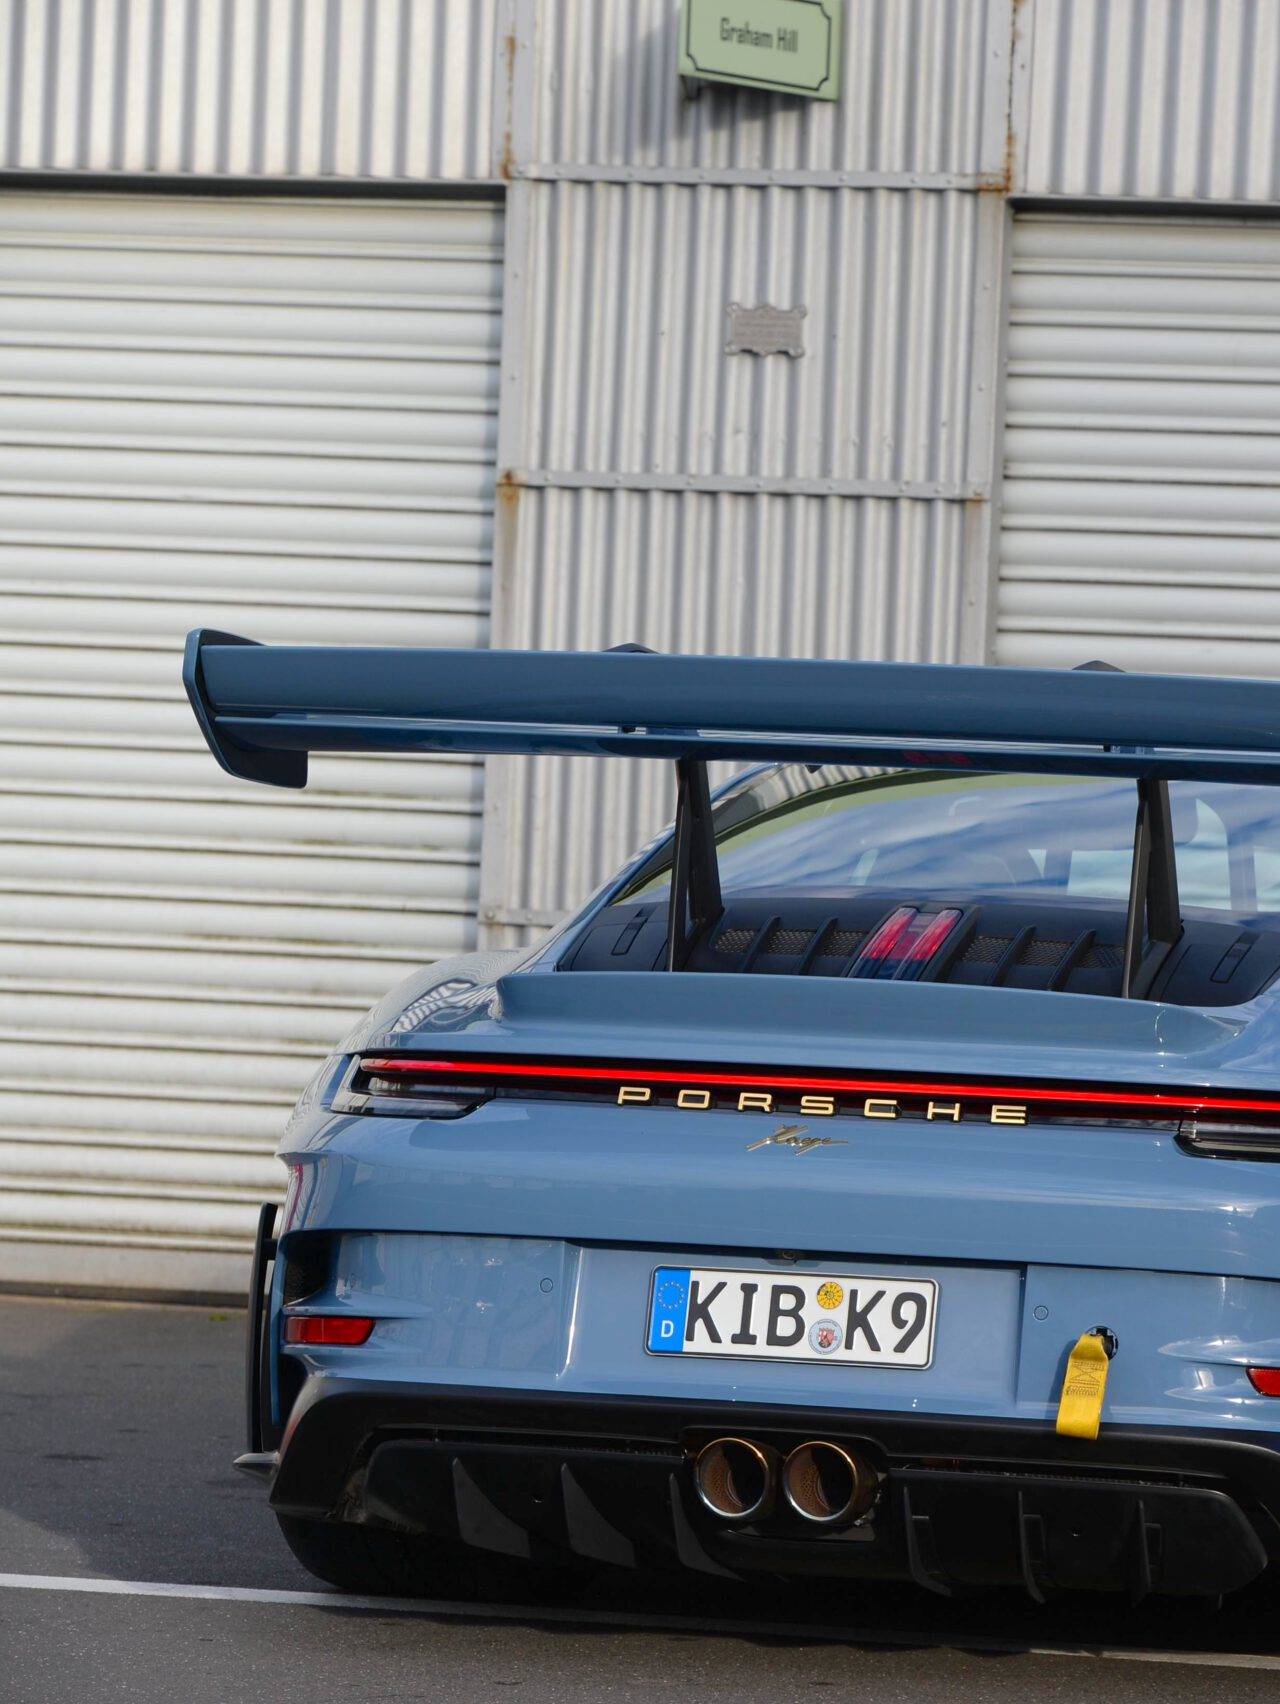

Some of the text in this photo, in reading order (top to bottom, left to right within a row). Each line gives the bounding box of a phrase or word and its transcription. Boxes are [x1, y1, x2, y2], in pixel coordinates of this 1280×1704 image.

[720, 17, 799, 53] Graham Hill
[617, 1086, 1028, 1124] PORSCHE
[660, 1320, 674, 1338] D
[685, 1280, 806, 1347] KIB
[844, 1288, 928, 1354] K9
